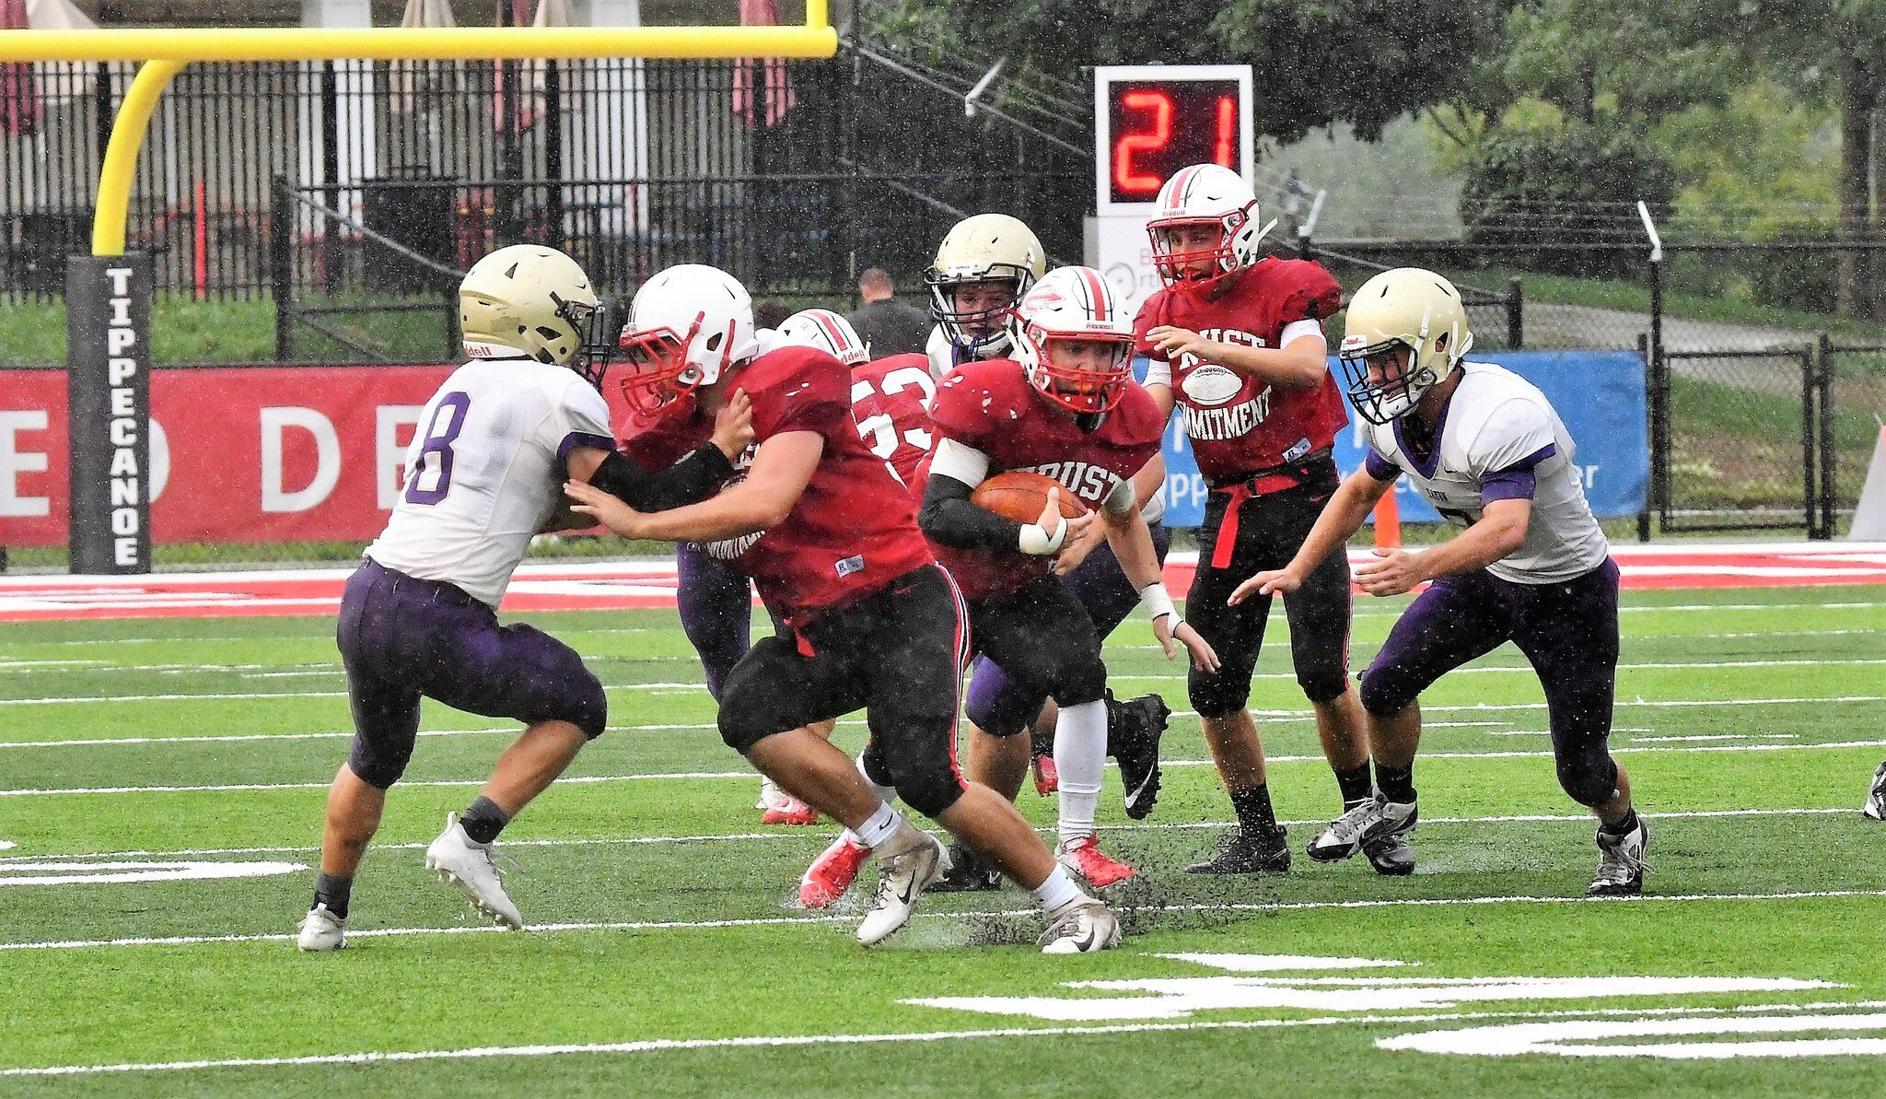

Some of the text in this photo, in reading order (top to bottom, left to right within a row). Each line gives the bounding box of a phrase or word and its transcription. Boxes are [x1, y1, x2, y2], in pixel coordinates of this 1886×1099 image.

[1112, 90, 1234, 194] 21
[106, 267, 139, 566] TIPPECANOE
[406, 390, 470, 506] 8
[1177, 385, 1272, 440] MMITMENT
